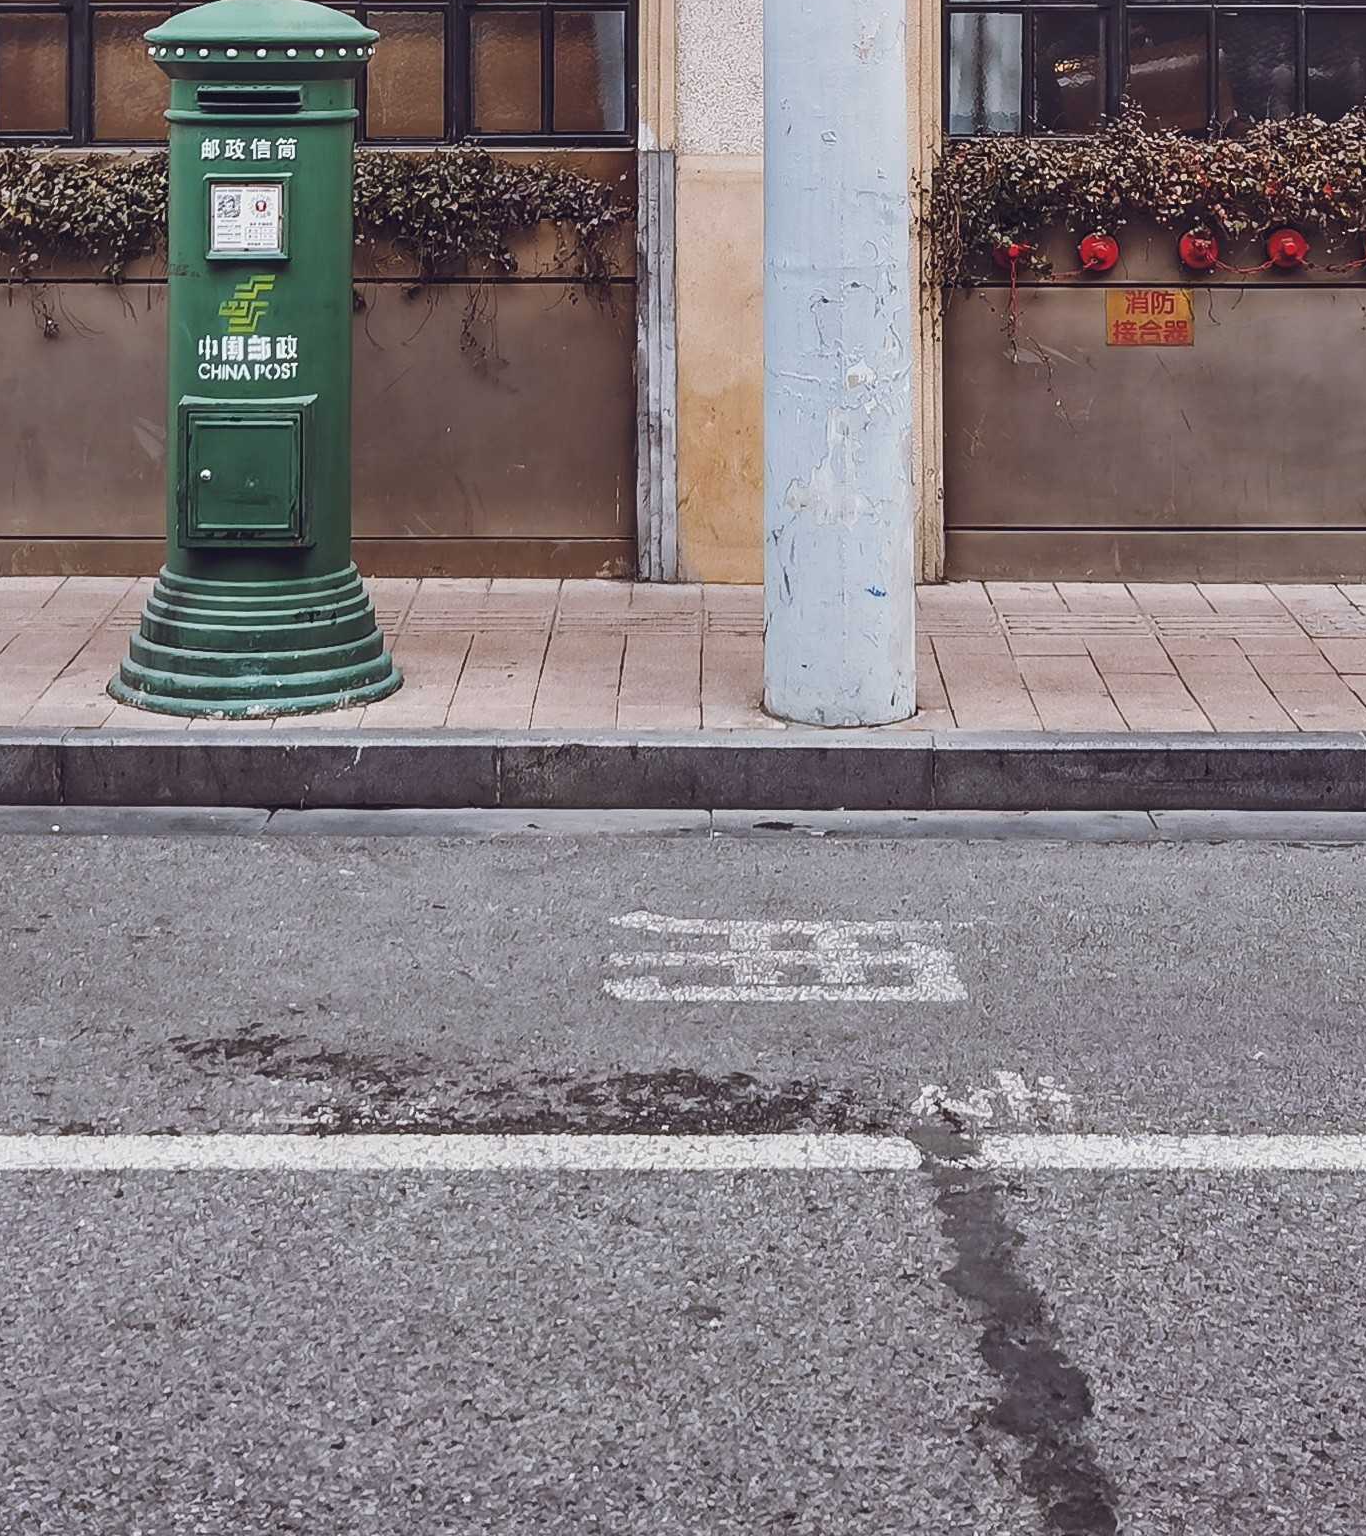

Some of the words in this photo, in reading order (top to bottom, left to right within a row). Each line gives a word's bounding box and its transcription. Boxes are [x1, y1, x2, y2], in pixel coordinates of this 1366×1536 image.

[200, 137, 298, 161] 邮政信筒
[1125, 289, 1176, 315] 消防
[1112, 319, 1189, 345] 接合器
[198, 334, 299, 362] 中国邮政
[197, 362, 252, 381] CHINA
[254, 362, 299, 381] POST
